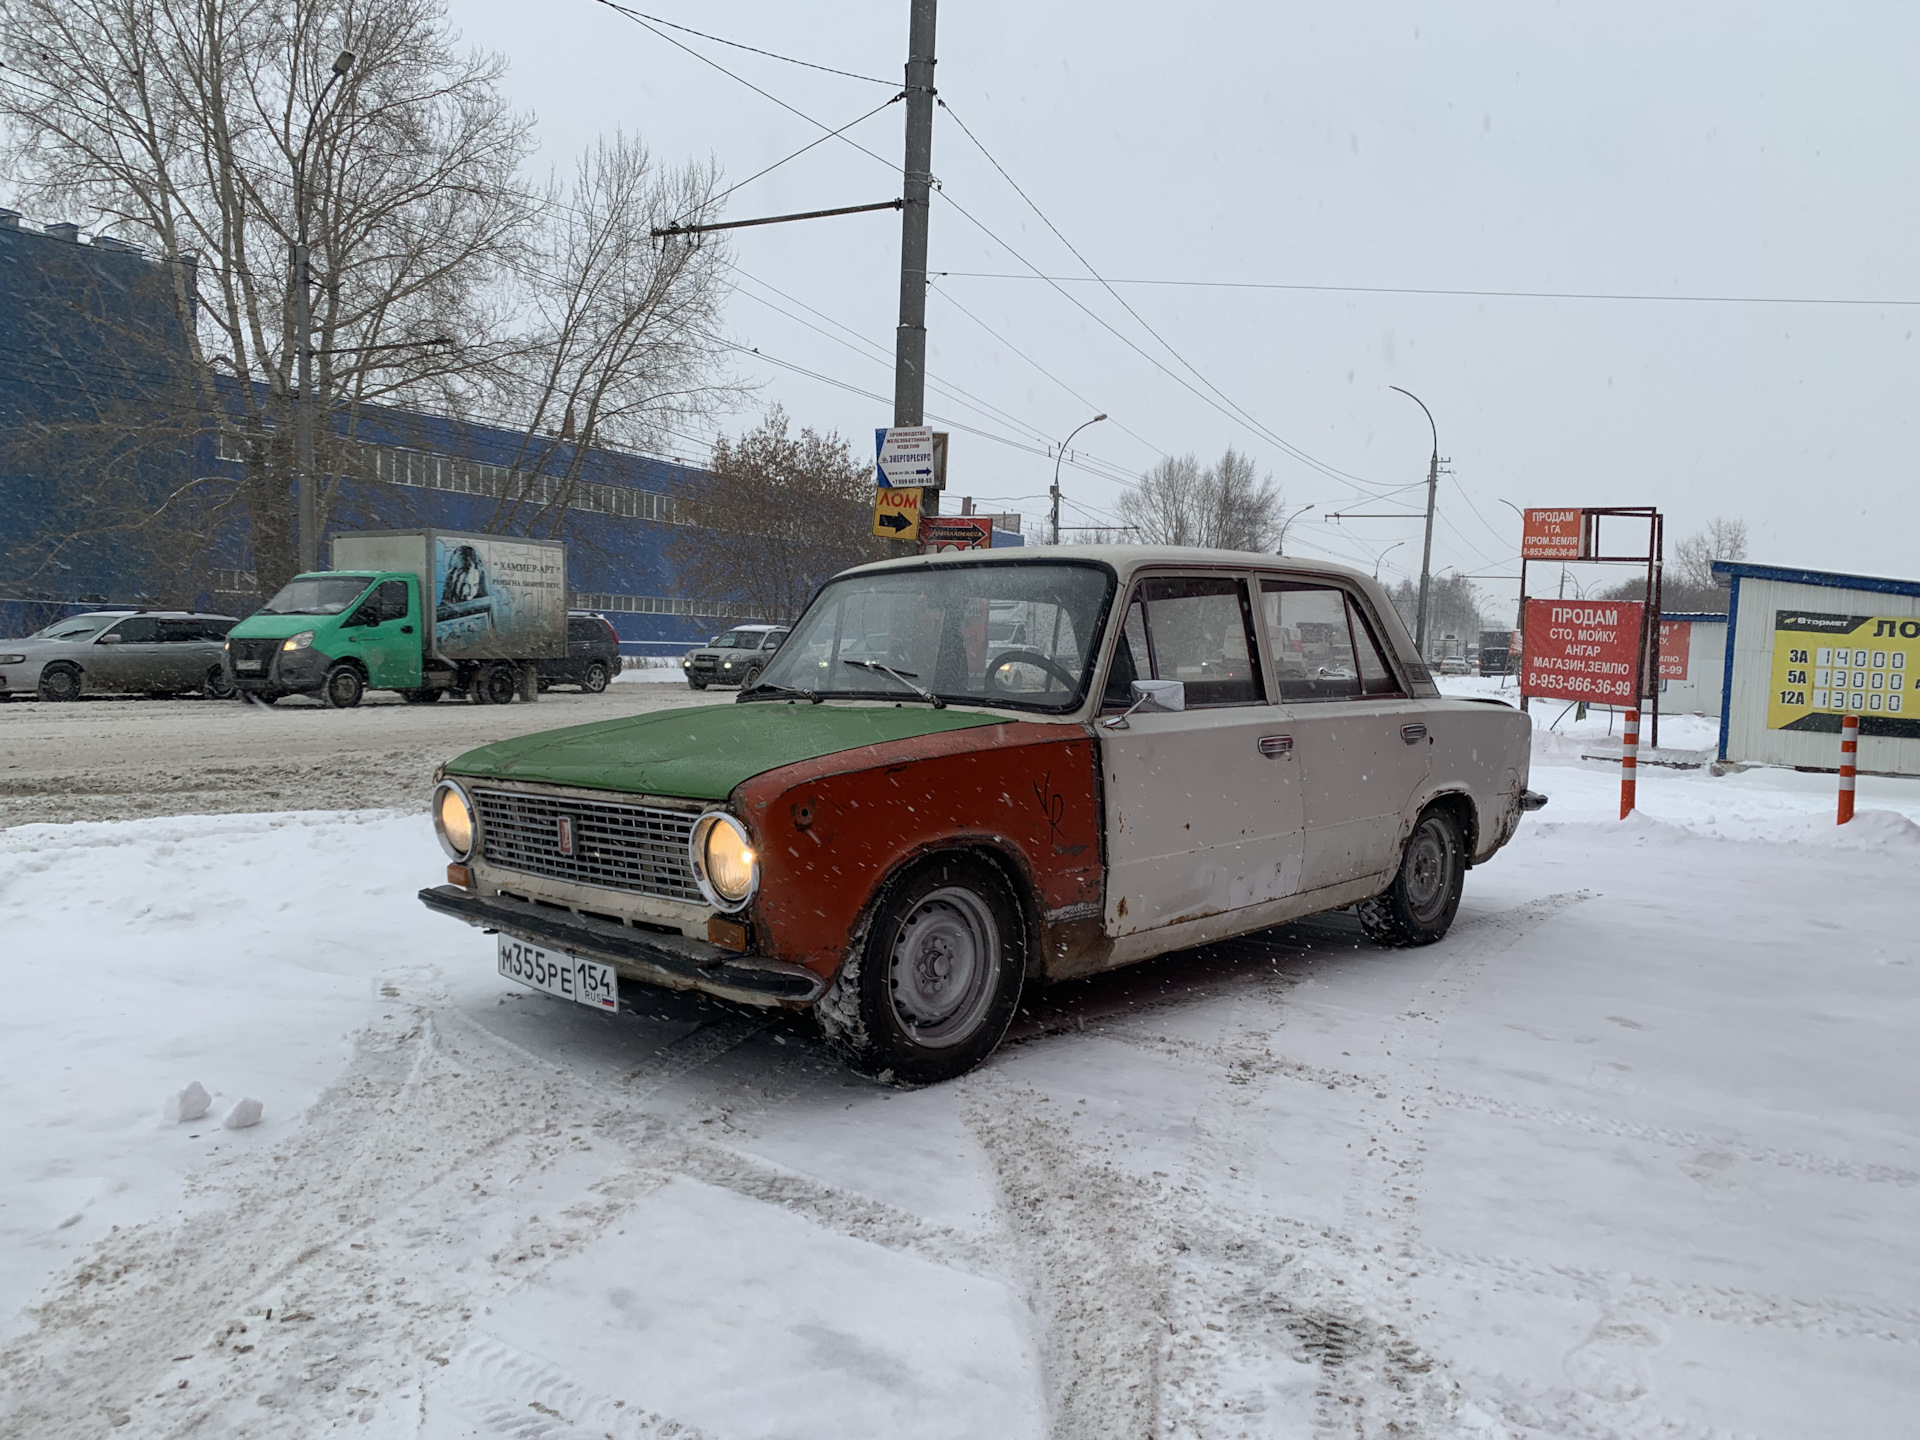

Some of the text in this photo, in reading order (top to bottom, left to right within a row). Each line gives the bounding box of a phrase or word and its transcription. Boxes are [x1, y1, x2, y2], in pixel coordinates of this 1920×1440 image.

[889, 453, 931, 463] ЭНЕРГОРЕСУРС
[879, 491, 918, 509] ЛОМ
[1532, 511, 1574, 523] ПРОДАМ
[1544, 525, 1561, 534] 1 ГА
[1524, 536, 1578, 546] ПРОМ.ЗЕМЛЯ
[1522, 547, 1578, 556] 8-953-866-36-99
[1551, 607, 1618, 627] ПРОДАМ
[1797, 617, 1849, 627] Втормет
[1550, 628, 1618, 644] СТО, МОЙКУ,
[1564, 644, 1602, 657] АНГАР
[1789, 649, 1904, 669] 3А 14000
[1528, 672, 1631, 696] 8-953-866-36-99
[1787, 670, 1807, 684] 5А
[1824, 671, 1902, 690] 13000
[1780, 691, 1900, 711] 12А 13000
[502, 943, 611, 996] М355РЕ 154
[584, 990, 602, 1003] RUS
